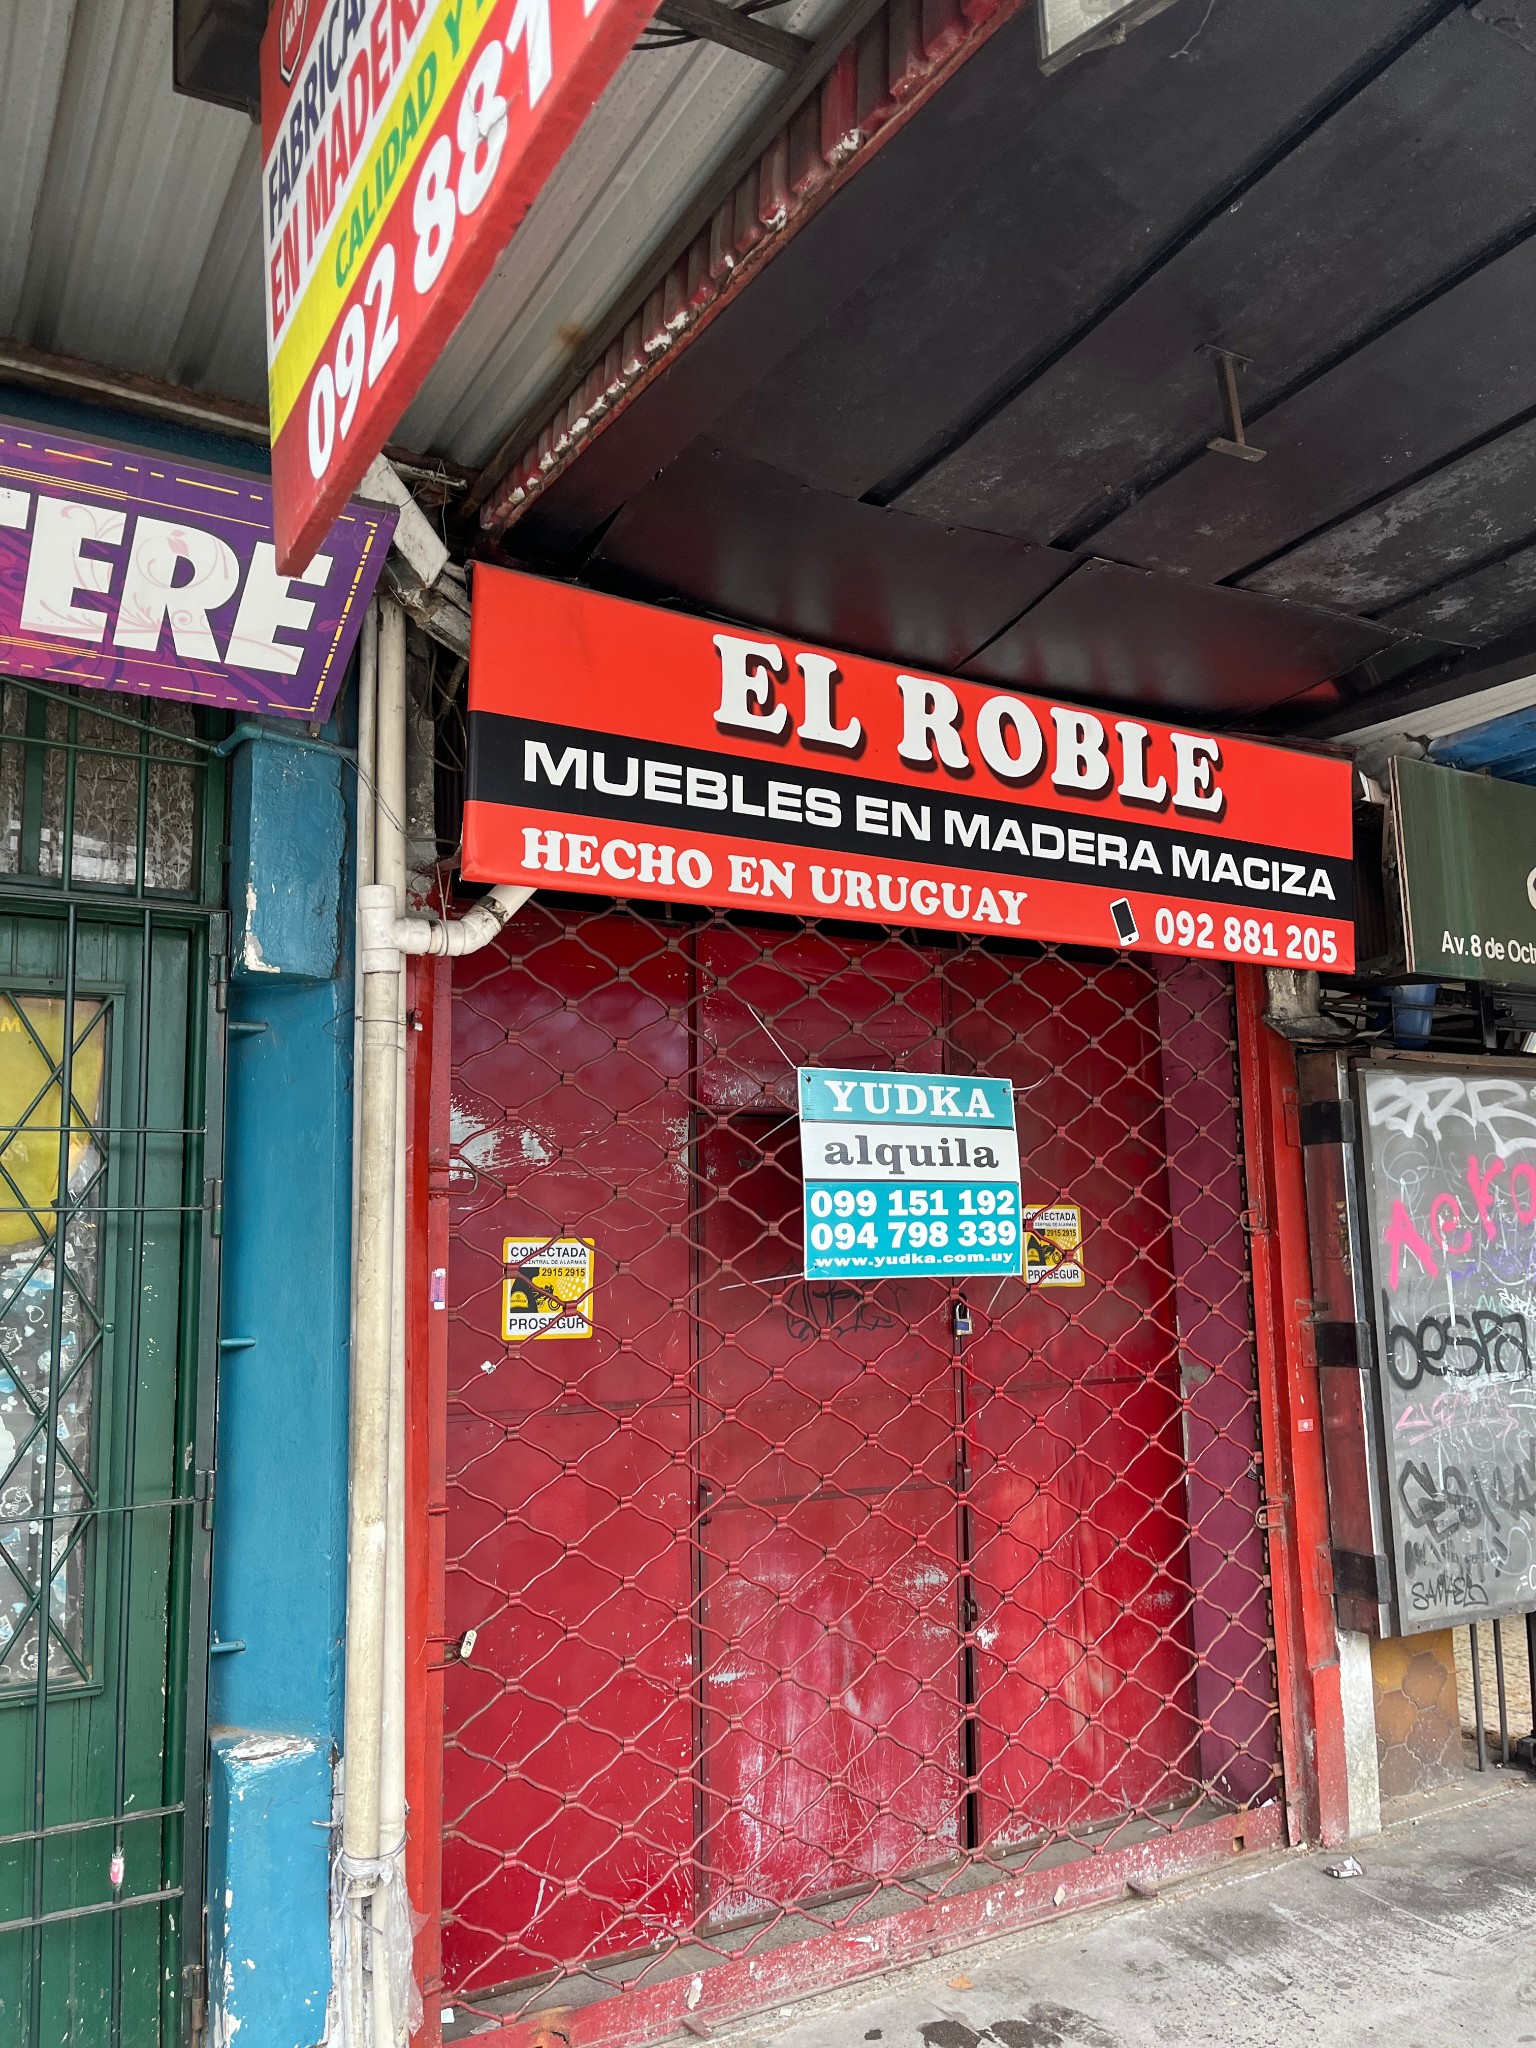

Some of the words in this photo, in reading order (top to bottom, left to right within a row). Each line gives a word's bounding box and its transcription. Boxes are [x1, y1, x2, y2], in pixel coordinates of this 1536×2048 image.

[268, 0, 366, 244] FABRICA
[271, 199, 300, 342] EN
[306, 0, 426, 267] MADER
[336, 50, 438, 288] CALIDAD
[308, 242, 399, 480] 092
[712, 633, 862, 749] EL
[896, 674, 1224, 814] ROBLE
[523, 739, 843, 828] MUEBLES
[855, 794, 932, 842] EN
[943, 809, 1163, 876] MADERA
[1171, 845, 1337, 901] MACIZA
[520, 826, 713, 888] HECHO
[726, 854, 797, 899] EN
[808, 864, 1029, 926] URUGUAY
[1154, 907, 1215, 951] 092
[1222, 917, 1279, 958] 881
[1286, 925, 1338, 965] 205
[1484, 936, 1505, 960] de
[824, 1080, 995, 1119] YUDKA
[824, 1135, 1000, 1175] alquila
[810, 1189, 878, 1218] 099
[888, 1189, 949, 1217] 151
[958, 1189, 1016, 1216] 192
[810, 1221, 879, 1251] 094
[887, 1220, 949, 1248] 798
[957, 1219, 1017, 1247] 339
[814, 1252, 1014, 1268] www.yudka.com.uy
[542, 1268, 562, 1276] 2915
[565, 1268, 585, 1276] 2915
